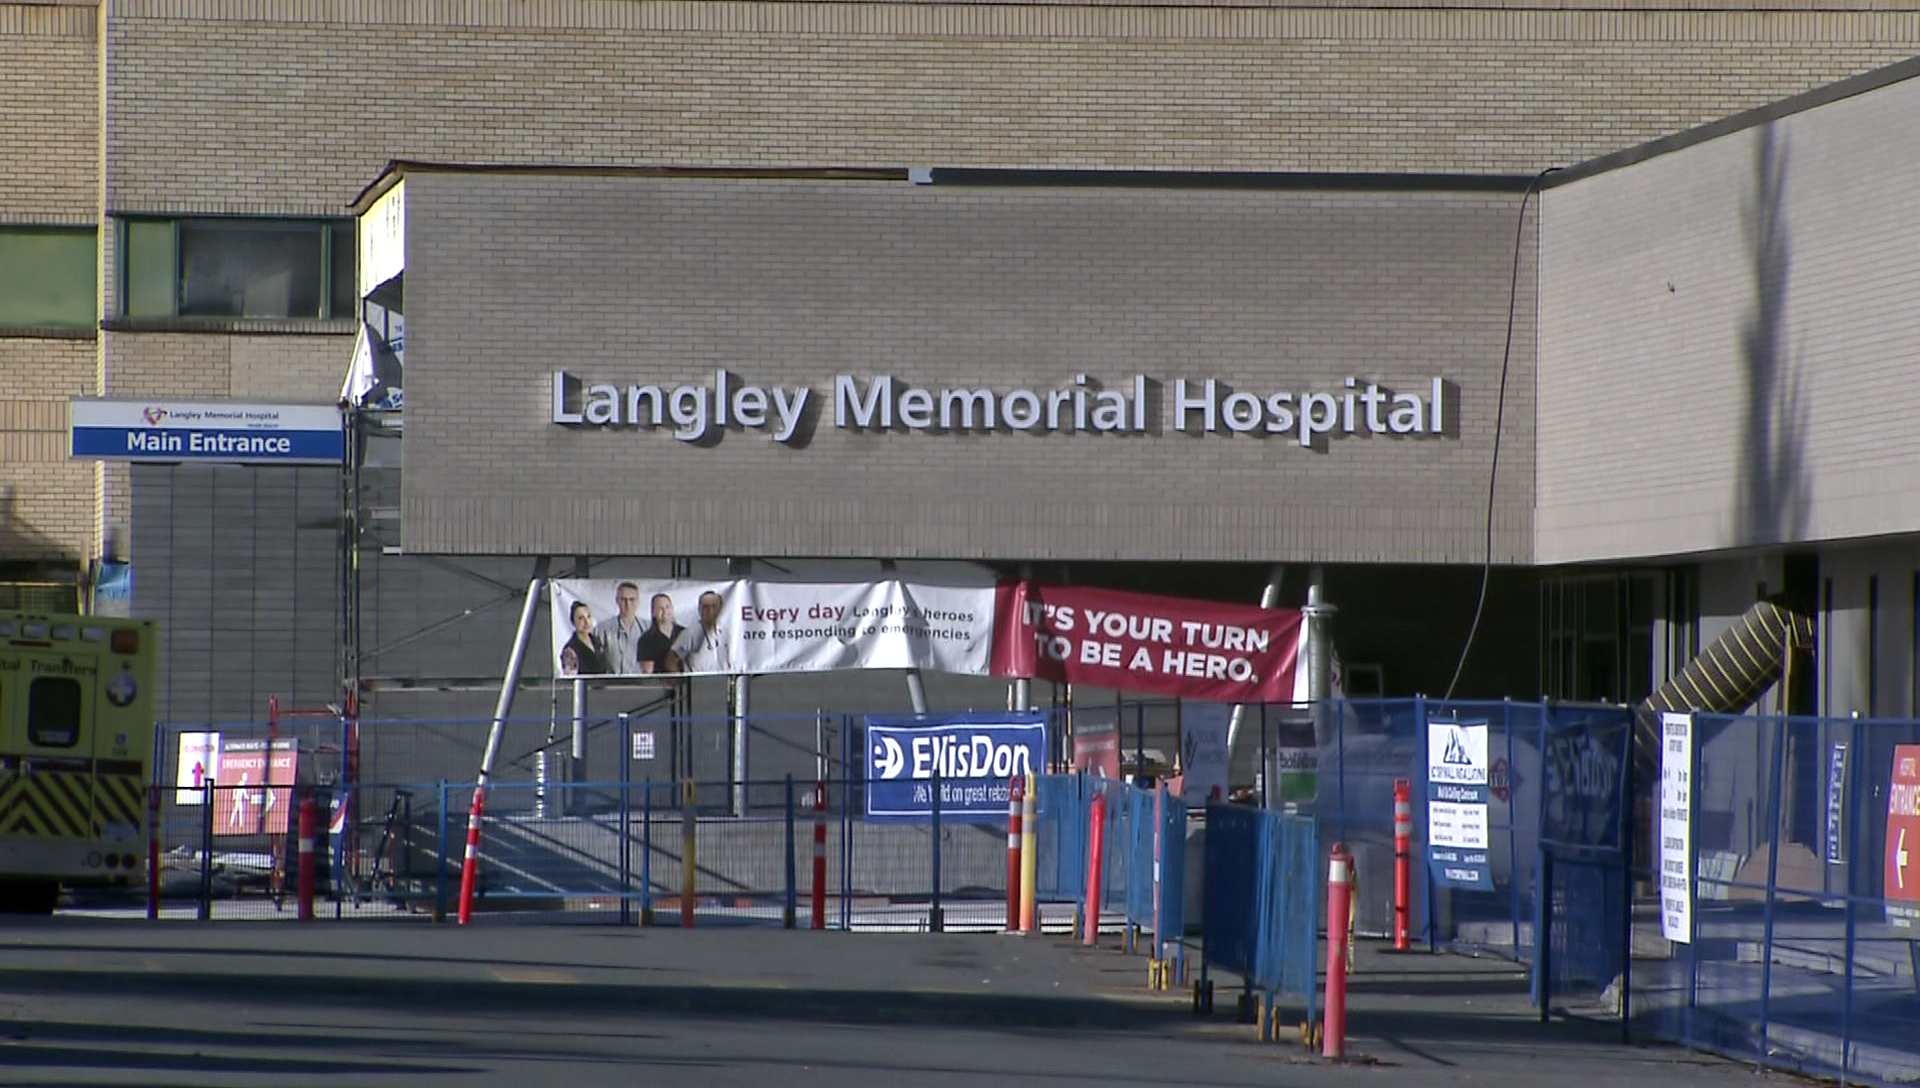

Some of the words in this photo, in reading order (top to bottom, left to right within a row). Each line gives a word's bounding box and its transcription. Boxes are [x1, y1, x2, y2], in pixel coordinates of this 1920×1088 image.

[170, 410, 201, 420] Langley
[204, 411, 243, 419] Memorial
[245, 411, 279, 420] Hospital
[553, 369, 810, 441] Langley
[835, 373, 1146, 430] Memorial
[1174, 376, 1443, 447] Hospital
[127, 432, 181, 451] Main
[189, 432, 291, 452] Entrance
[741, 605, 799, 623] Every
[808, 603, 845, 621] day
[924, 607, 974, 622] heroes
[743, 630, 766, 640] are
[771, 626, 856, 640] responding
[881, 625, 971, 641] emergencies
[1023, 601, 1075, 631] IT'S
[1084, 609, 1173, 643] YOUR
[1181, 621, 1269, 653] TURN
[1034, 632, 1072, 660] TO
[1080, 640, 1122, 667] BE
[1128, 647, 1153, 672] A
[1162, 649, 1259, 683] HERO.
